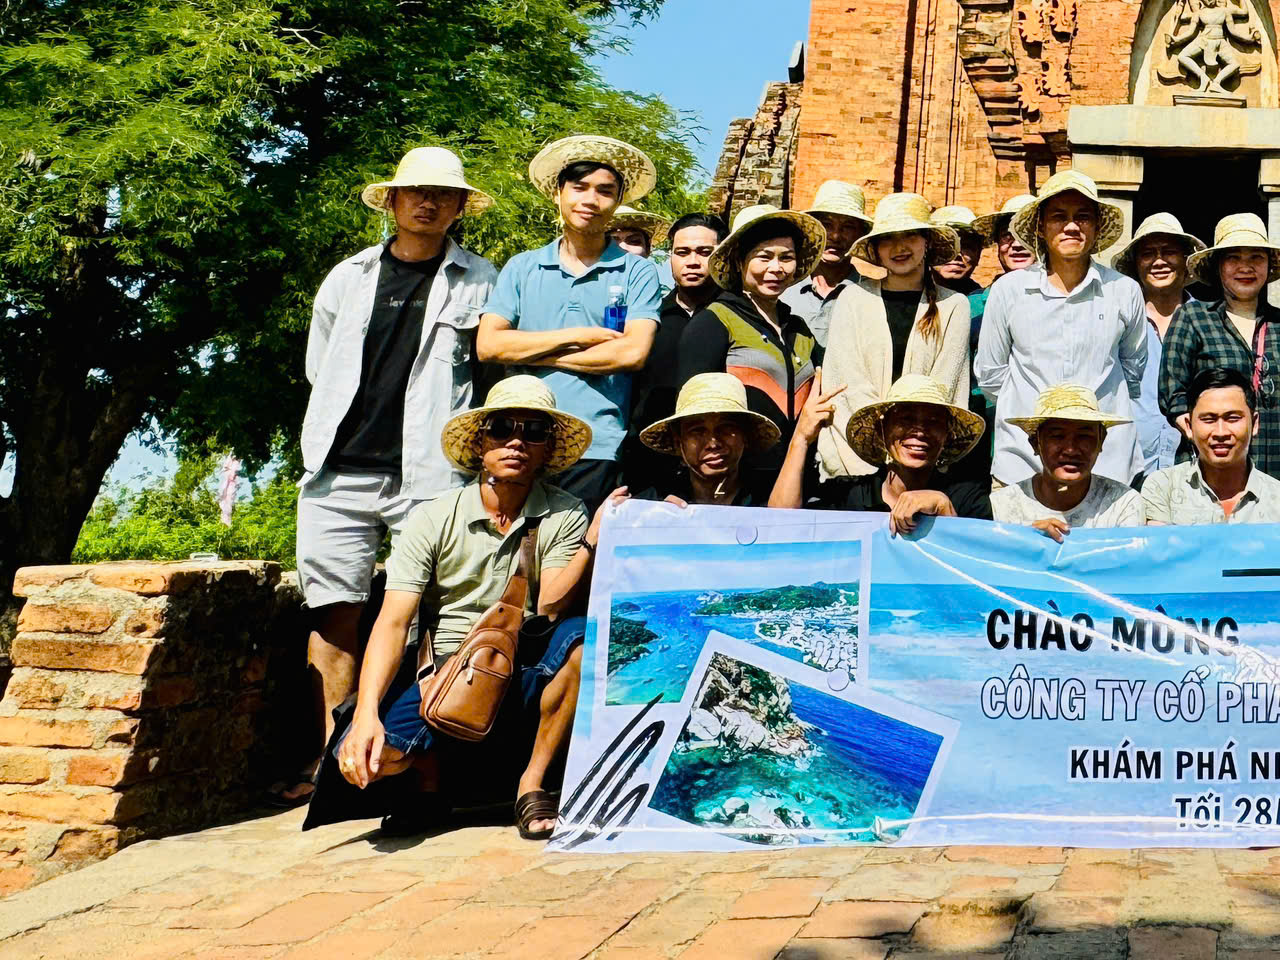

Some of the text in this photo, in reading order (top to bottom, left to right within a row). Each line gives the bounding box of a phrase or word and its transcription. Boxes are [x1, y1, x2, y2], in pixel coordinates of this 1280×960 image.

[986, 600, 1239, 656] CHÀO MỪNG
[981, 664, 1086, 721] CÔNG
[1096, 680, 1147, 722] TY
[1154, 665, 1211, 723] CỔ
[1071, 740, 1162, 780] KHÁM
[1176, 741, 1237, 780] PHÁ
[1175, 793, 1221, 828] Tối
